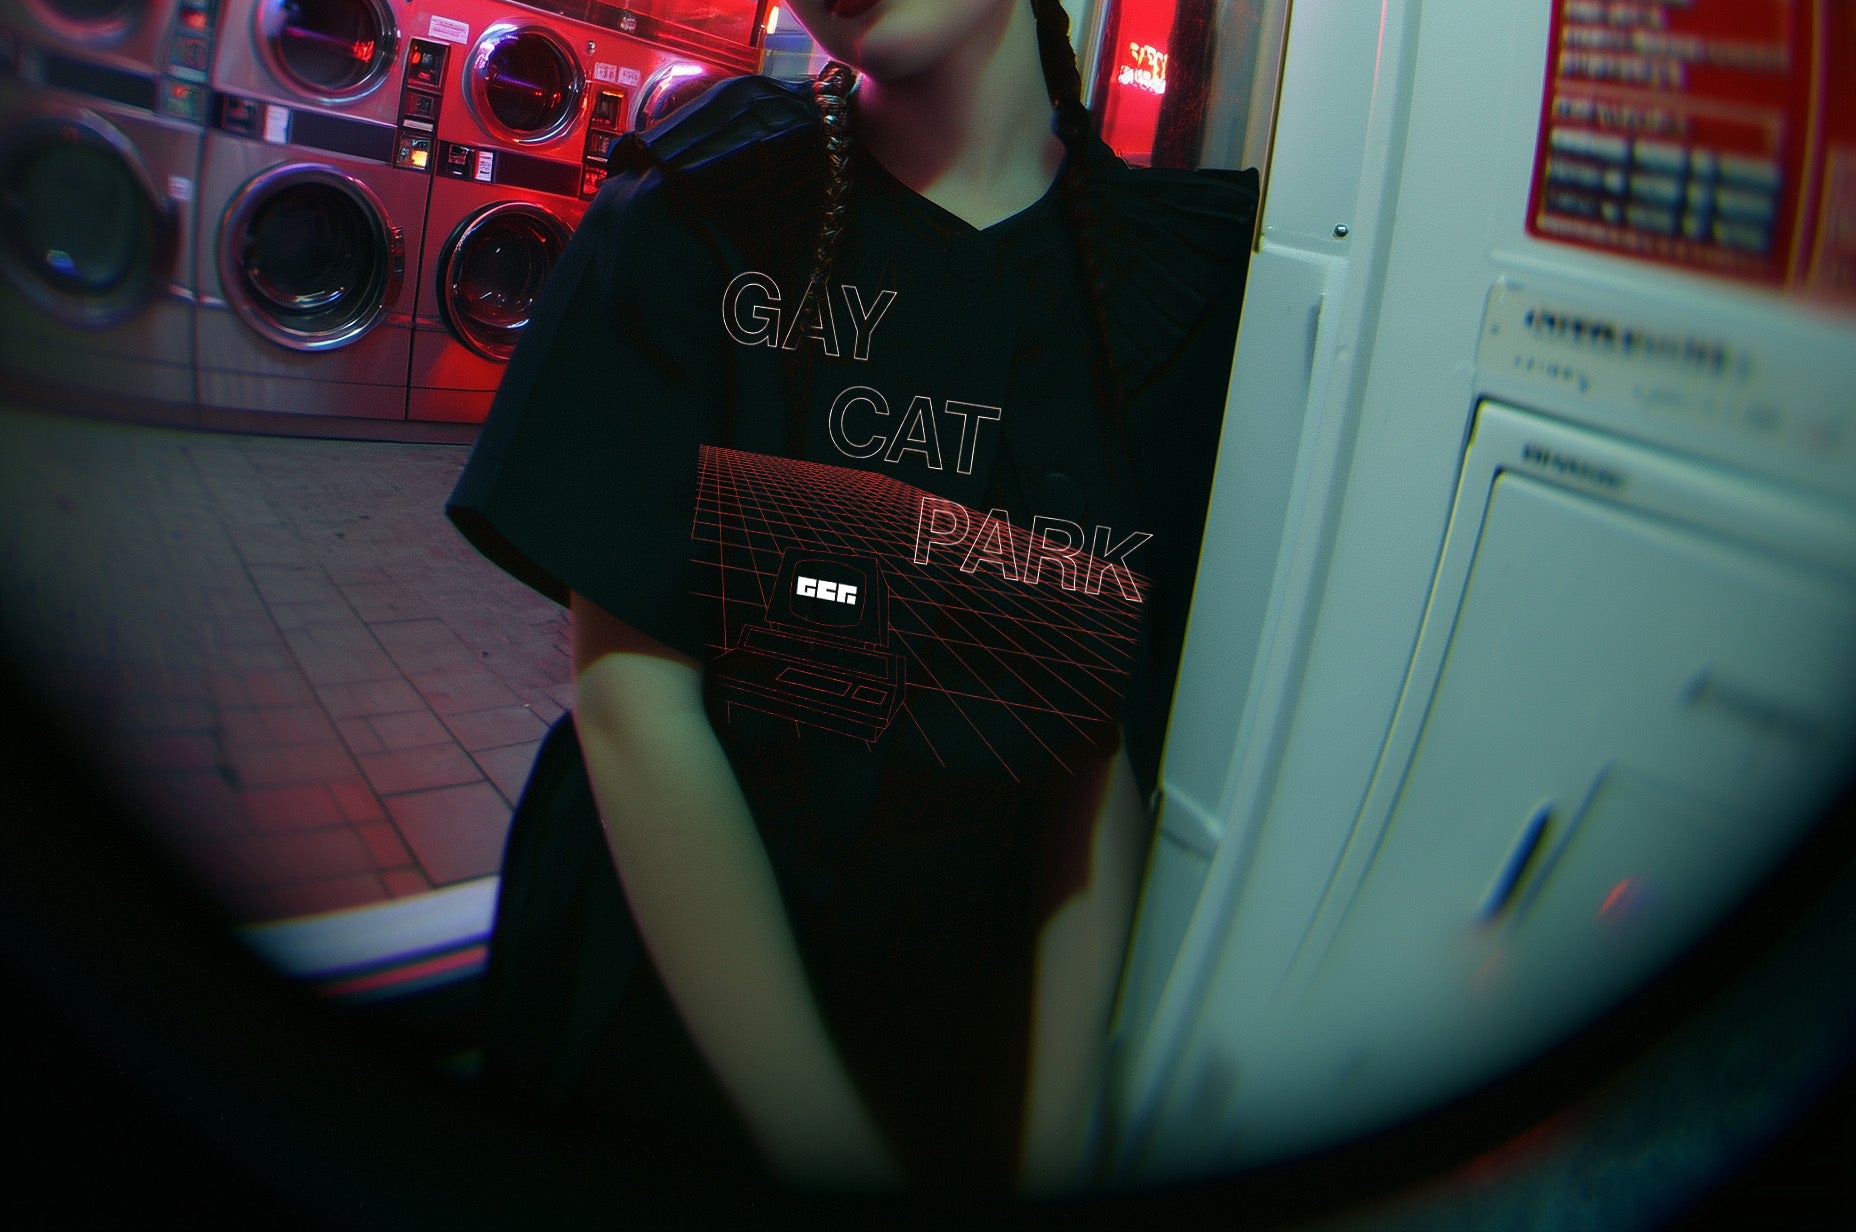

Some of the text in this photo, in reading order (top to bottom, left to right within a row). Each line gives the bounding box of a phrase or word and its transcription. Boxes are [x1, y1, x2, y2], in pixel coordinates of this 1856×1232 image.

[722, 271, 898, 361] GAY
[828, 385, 1002, 475] CAT
[913, 496, 1154, 603] PARK
